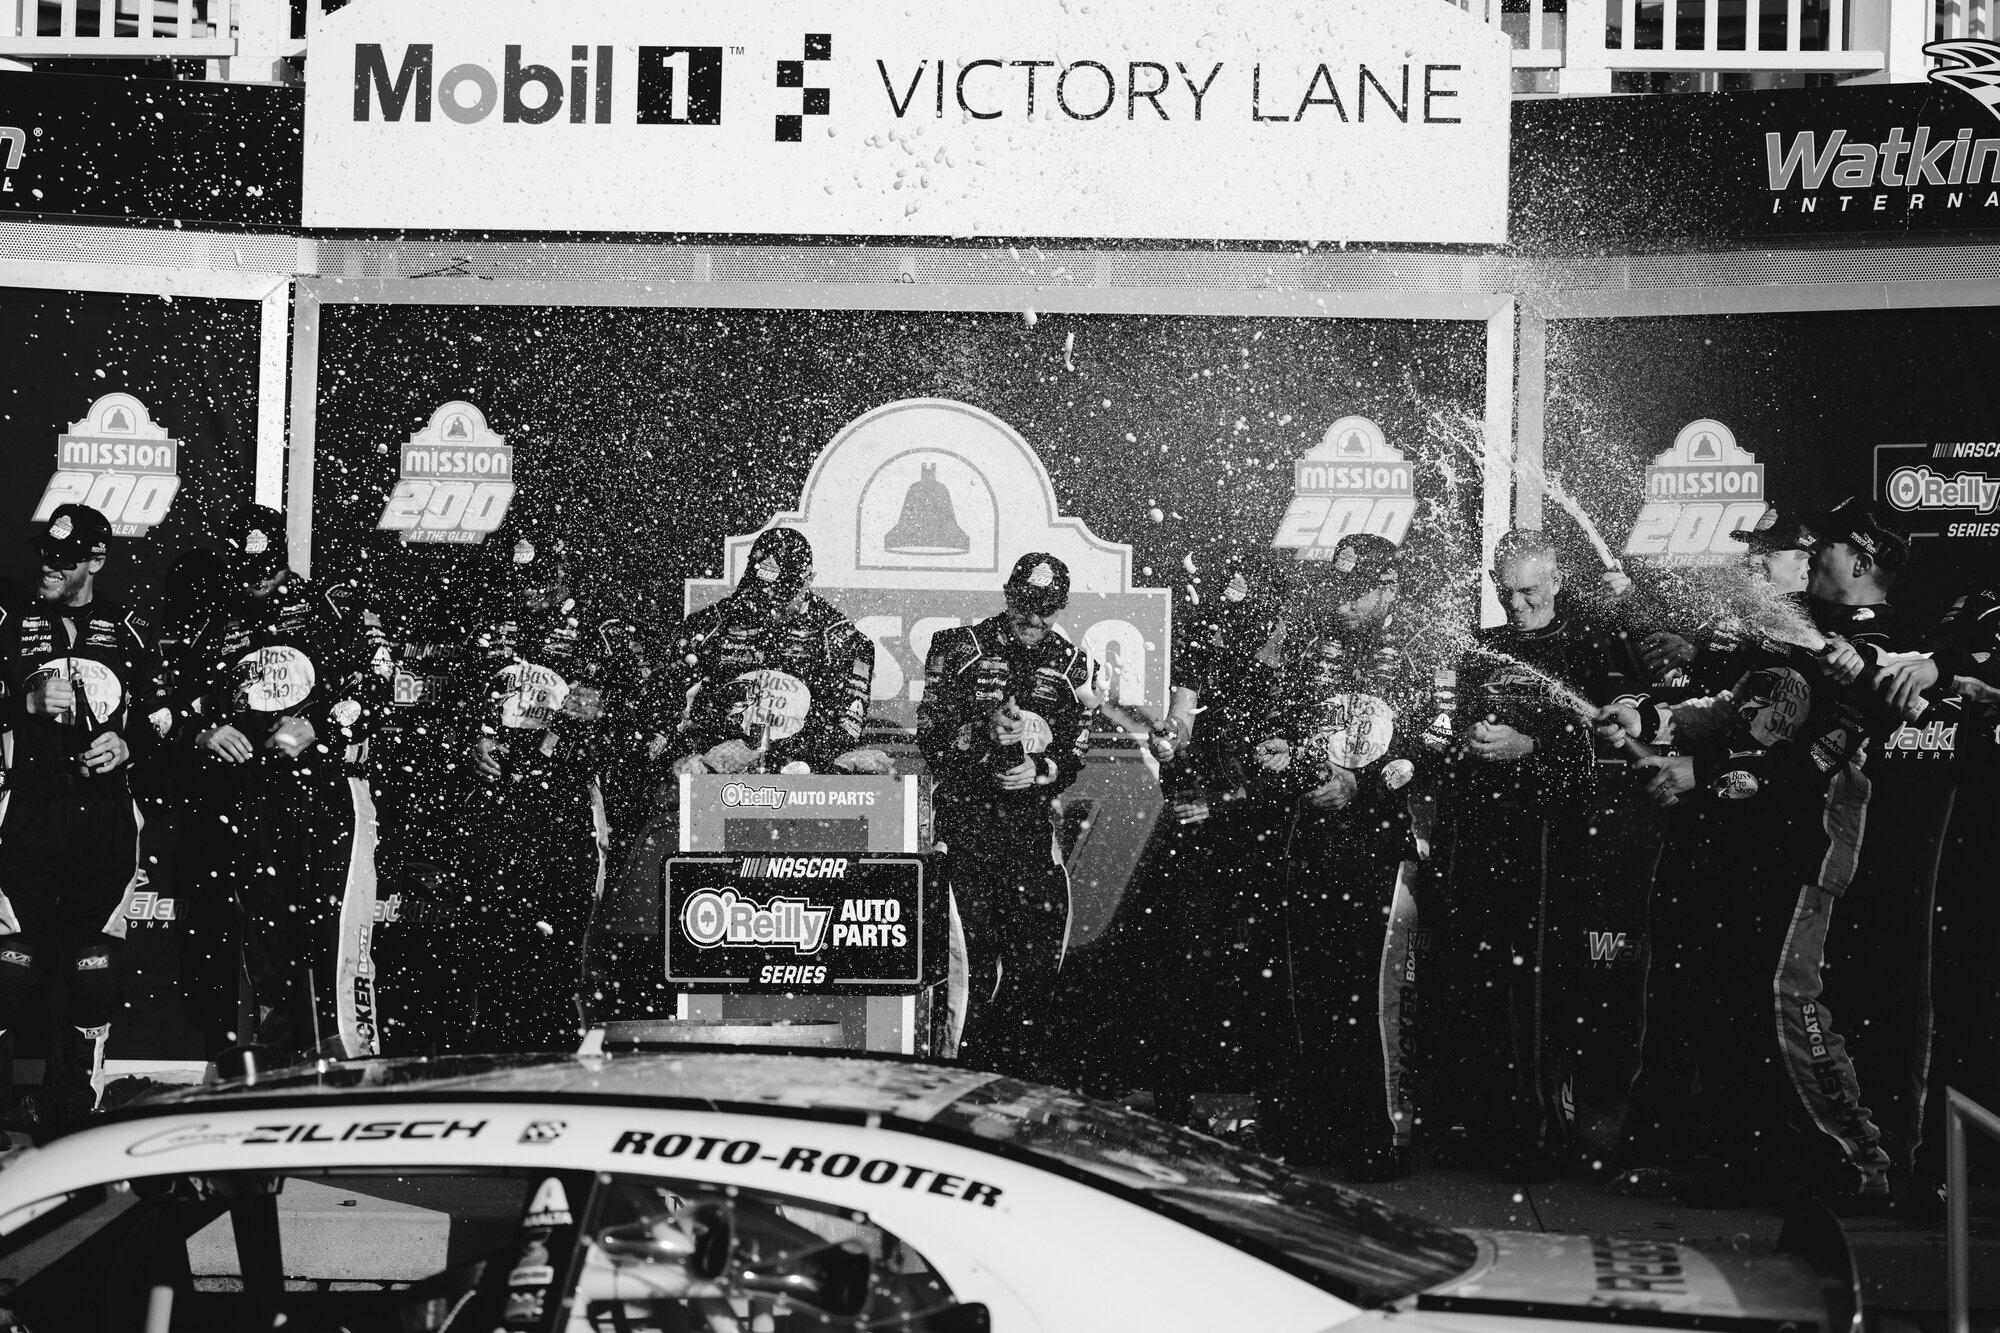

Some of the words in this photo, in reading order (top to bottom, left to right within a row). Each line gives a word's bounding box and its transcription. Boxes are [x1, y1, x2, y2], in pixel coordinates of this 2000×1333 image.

[353, 43, 613, 124] Mobil
[876, 58, 1224, 122] VICTORY
[1252, 62, 1462, 124] LANE
[32, 471, 181, 526] 200
[1889, 467, 2000, 512] O'Reilly
[376, 479, 516, 533] 200
[409, 531, 424, 541] AT
[426, 531, 447, 542] THE
[448, 532, 475, 542] GLEN
[1271, 497, 1417, 549] 200
[1947, 523, 2000, 537] SERIES
[258, 649, 296, 667] Bass
[262, 665, 288, 682] Pro
[759, 670, 799, 694] Bass
[1780, 667, 1811, 702] Bass
[721, 782, 787, 810] O'Reilly
[787, 790, 827, 806] AUTO
[828, 790, 875, 807] PARTS
[765, 857, 849, 879] NASCAR
[125, 891, 176, 920] Gle
[684, 889, 832, 952] O'Reilly
[840, 898, 901, 923] AUTO
[358, 925, 369, 975] BOATS
[833, 924, 908, 948] PARTS
[759, 965, 827, 985] SERIES
[1802, 1001, 1827, 1058] BOATS
[241, 1119, 490, 1146] ZILISCH
[611, 1129, 1006, 1209] ROTO-ROOTER
